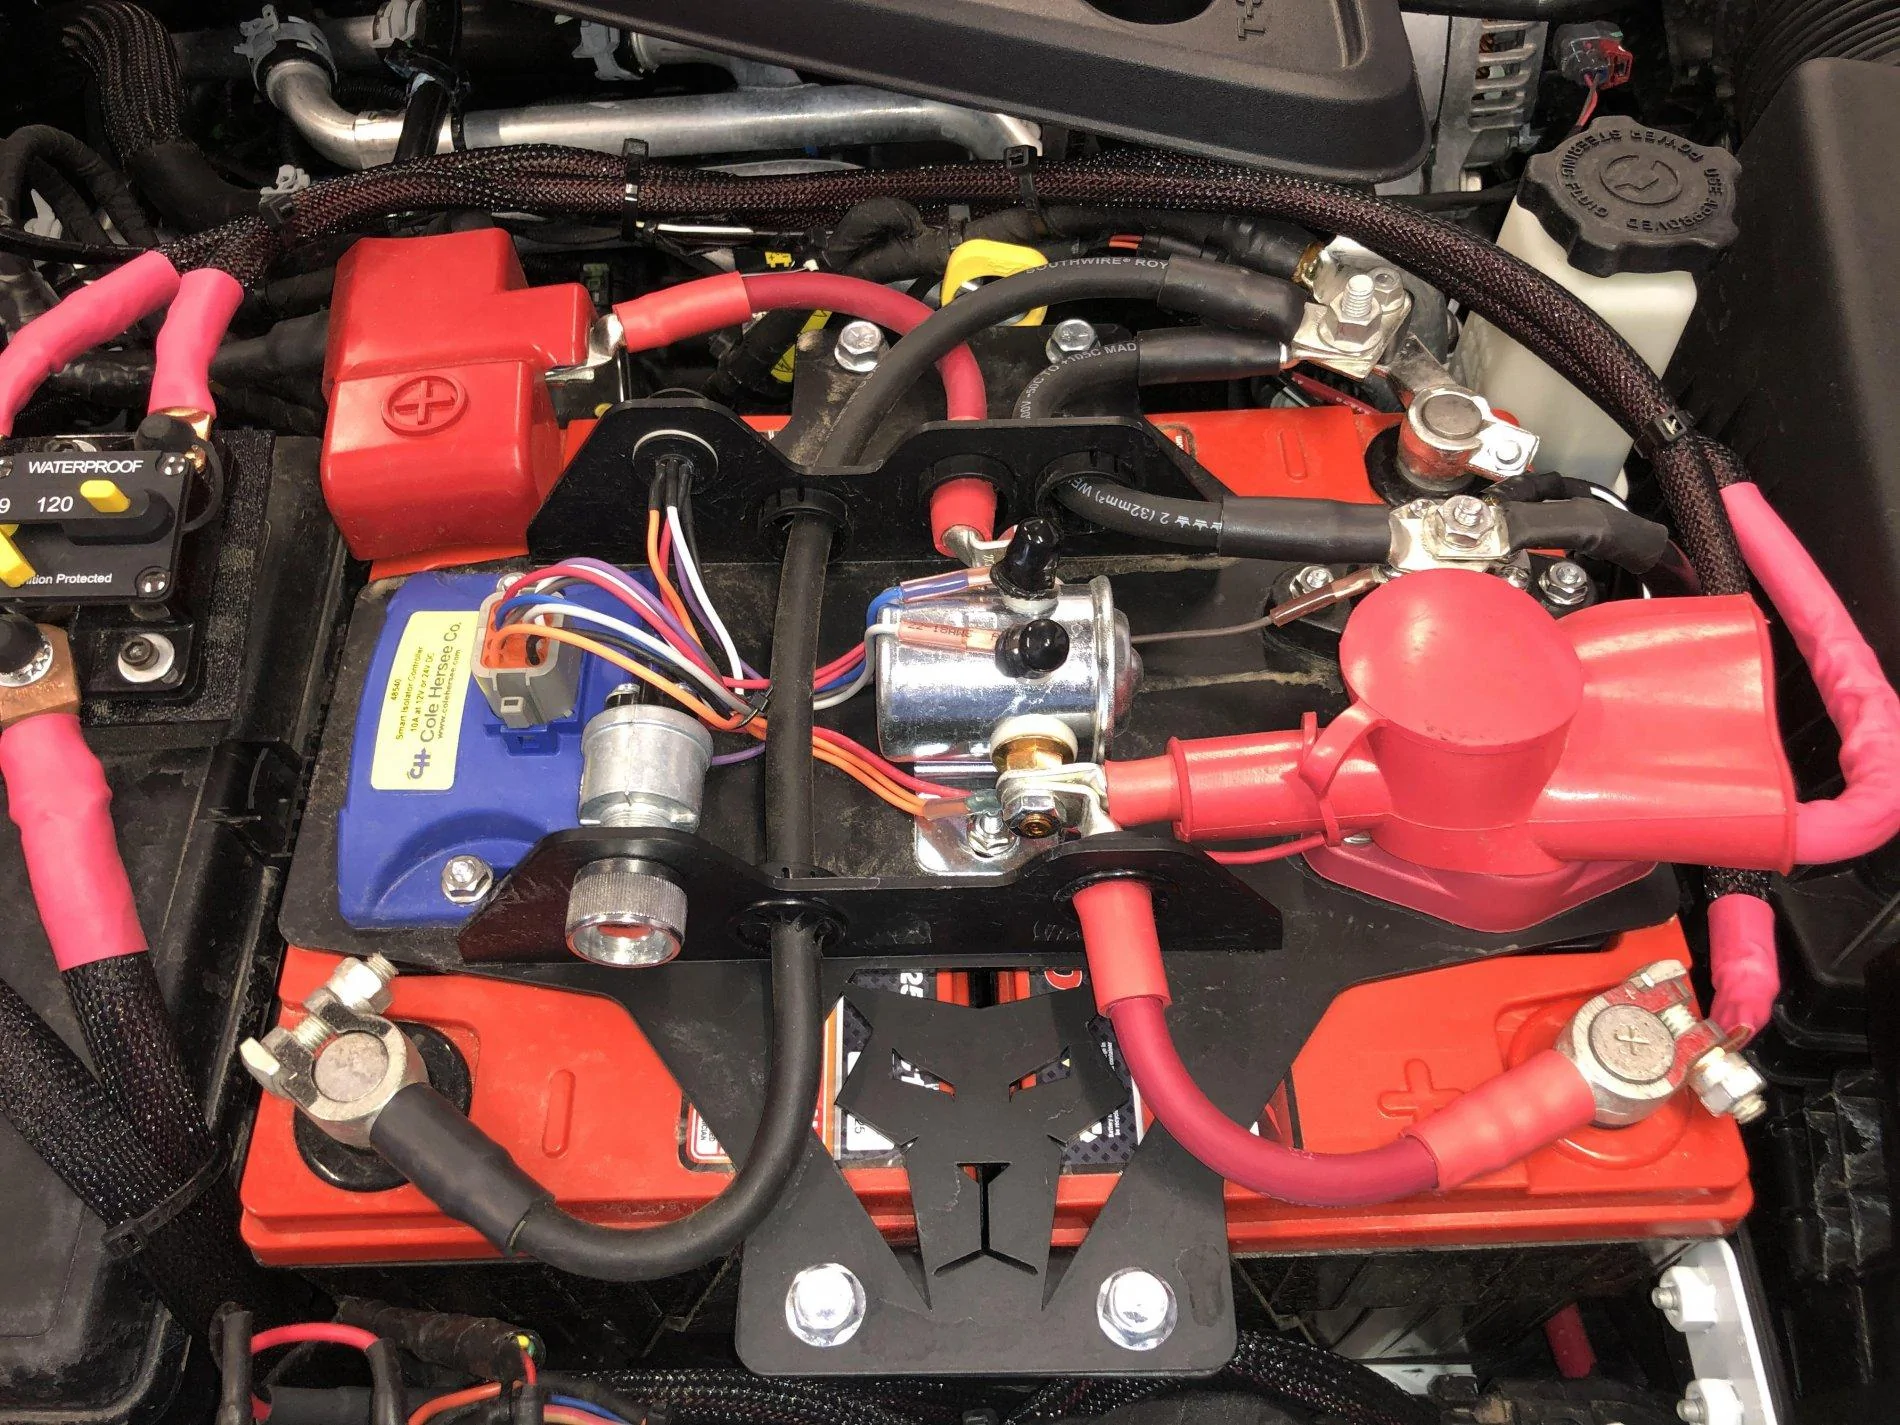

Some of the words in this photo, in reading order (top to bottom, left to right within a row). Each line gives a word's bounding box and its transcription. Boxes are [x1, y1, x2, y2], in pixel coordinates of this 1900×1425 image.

[1561, 129, 1623, 177] STEERING
[1629, 129, 1704, 163] POWER
[1704, 168, 1723, 196] USE
[1627, 197, 1719, 231] APPROVED
[28, 460, 144, 474] WATERPROOF
[37, 496, 74, 513] 120
[1160, 511, 1171, 525] 2
[56, 573, 113, 584] Protected
[443, 621, 462, 642] Co.
[428, 645, 453, 698] Hersee
[395, 716, 407, 740] Smart
[408, 646, 423, 682] Controller
[420, 703, 439, 743] Cole
